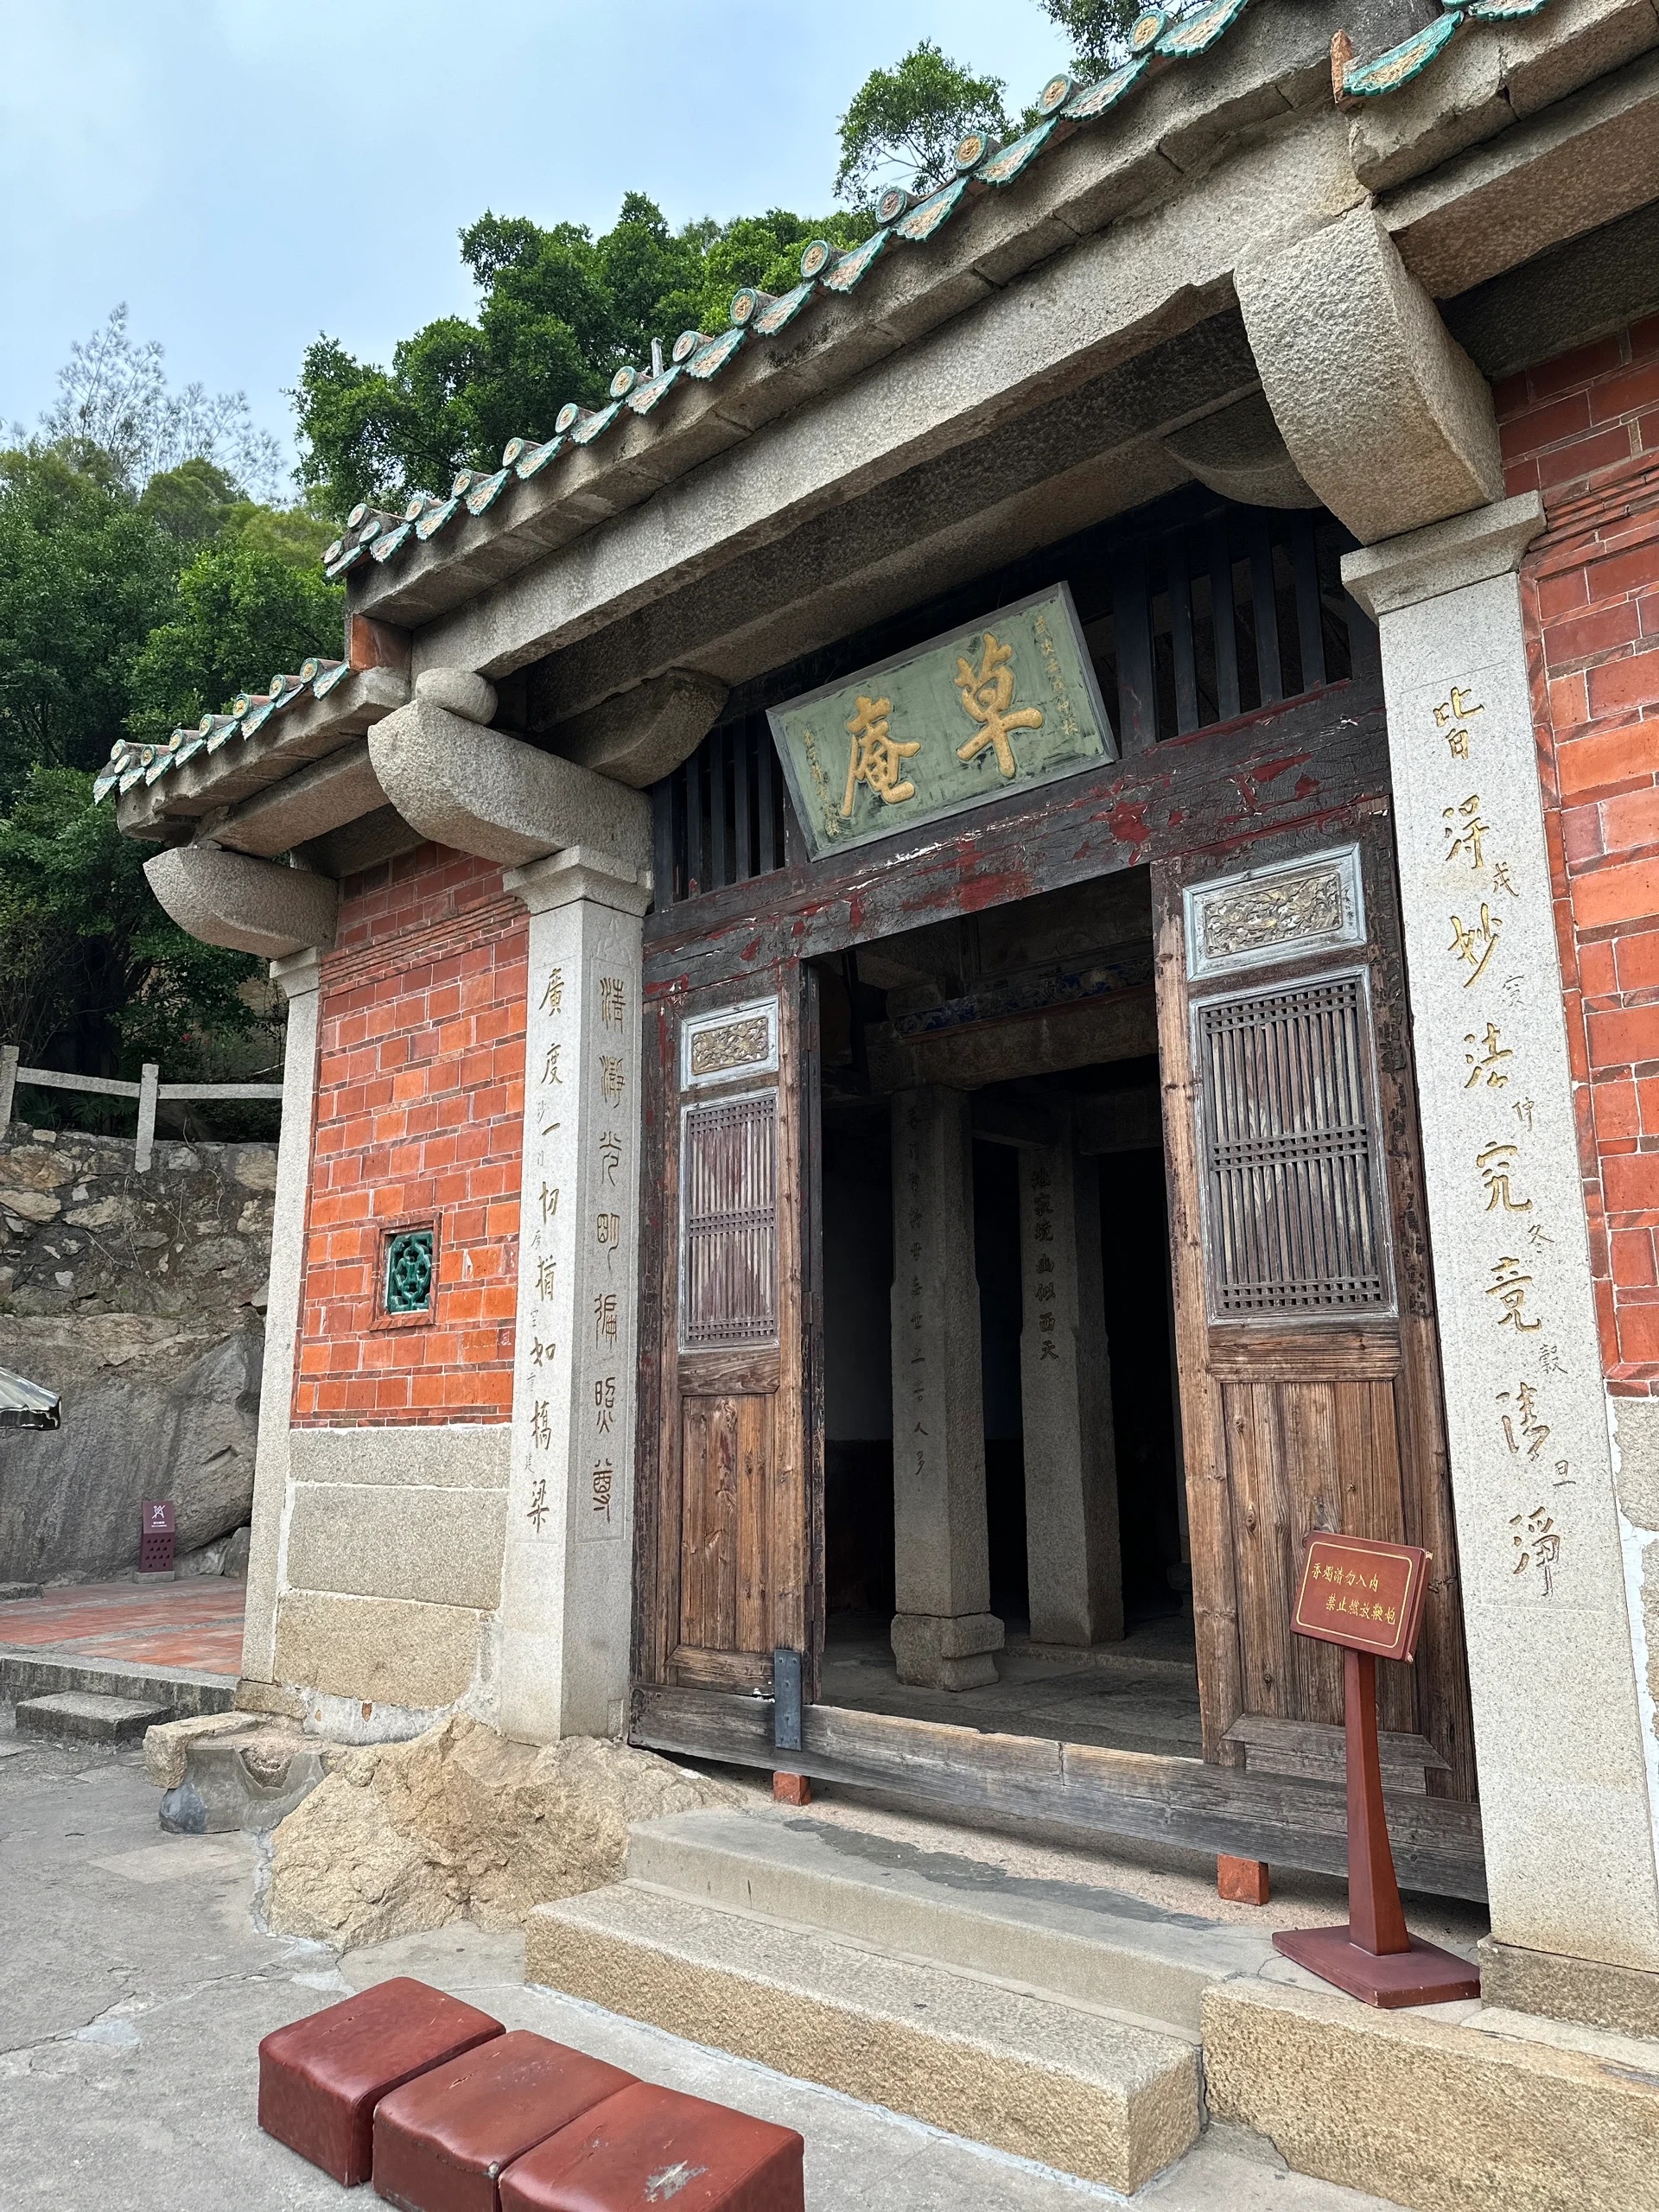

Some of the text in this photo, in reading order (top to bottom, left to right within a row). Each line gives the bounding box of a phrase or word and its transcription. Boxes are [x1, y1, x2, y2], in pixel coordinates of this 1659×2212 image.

[1325, 1592, 1396, 1625] 禁止燃放鞭炮
